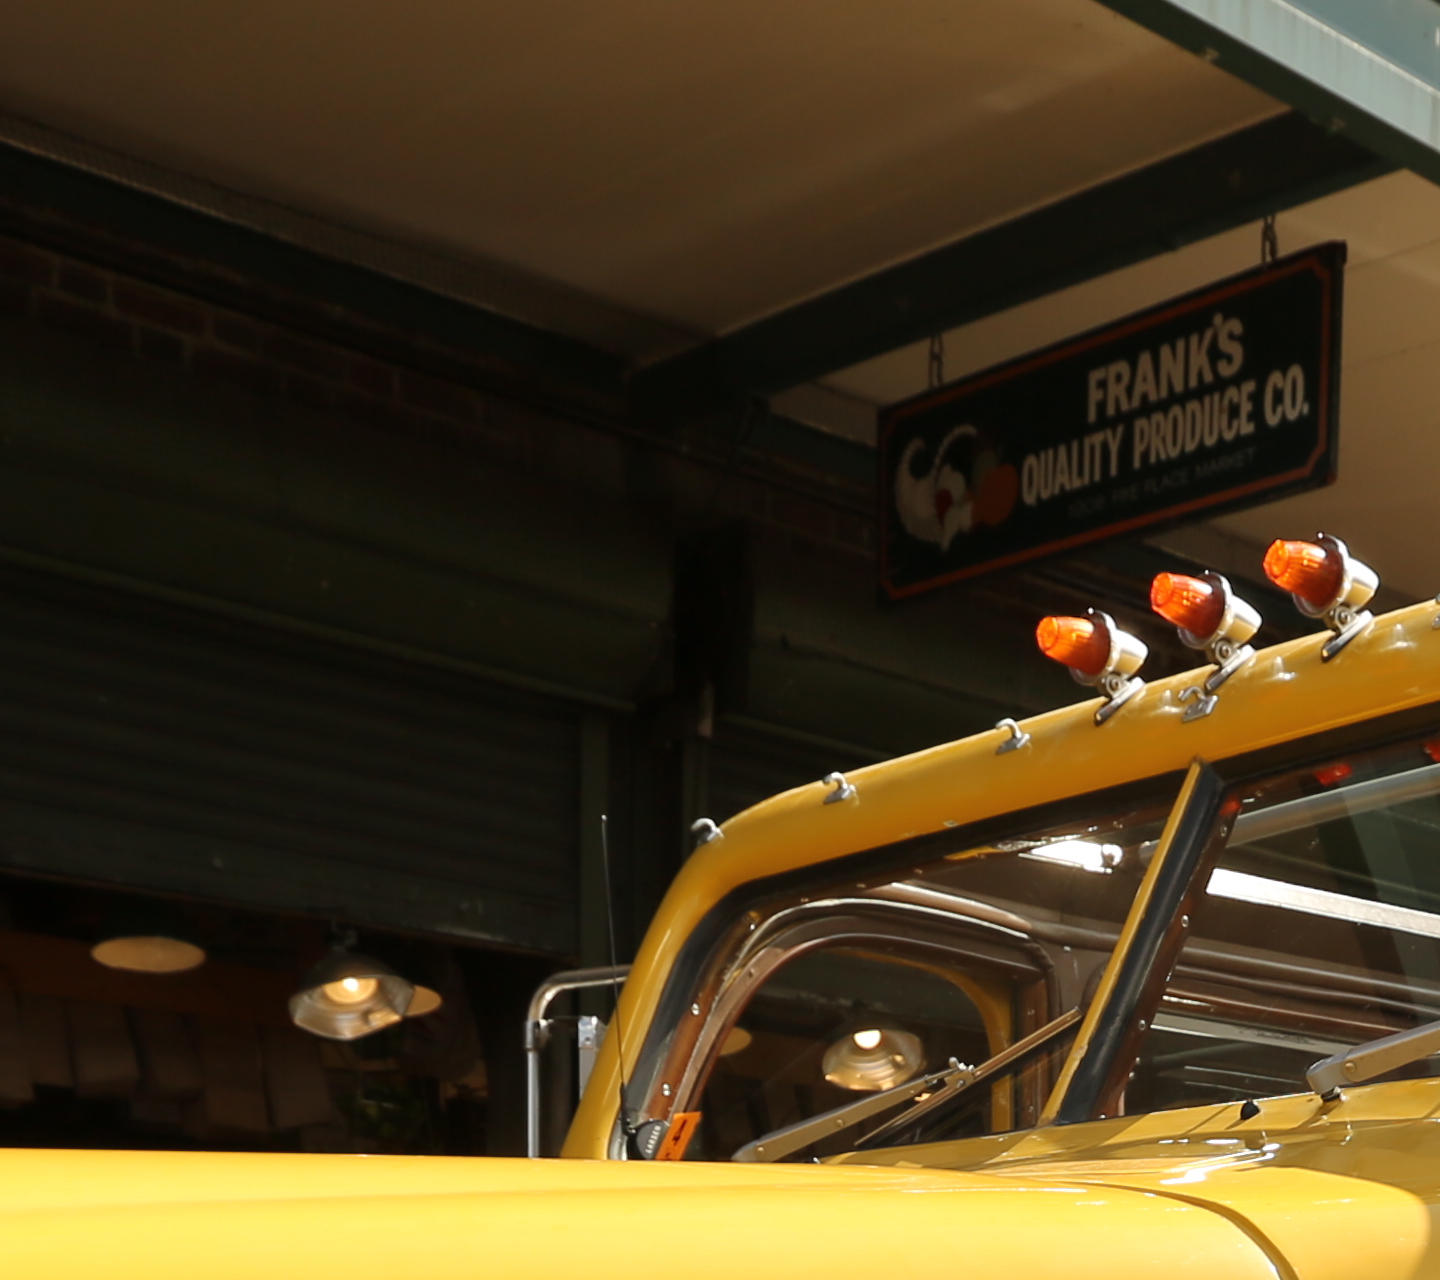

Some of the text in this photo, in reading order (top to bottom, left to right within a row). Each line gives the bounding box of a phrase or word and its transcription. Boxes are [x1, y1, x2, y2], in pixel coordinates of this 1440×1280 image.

[1086, 313, 1244, 424] FRANK'S
[1021, 363, 1309, 507] QUALITY PRODUCE CO.
